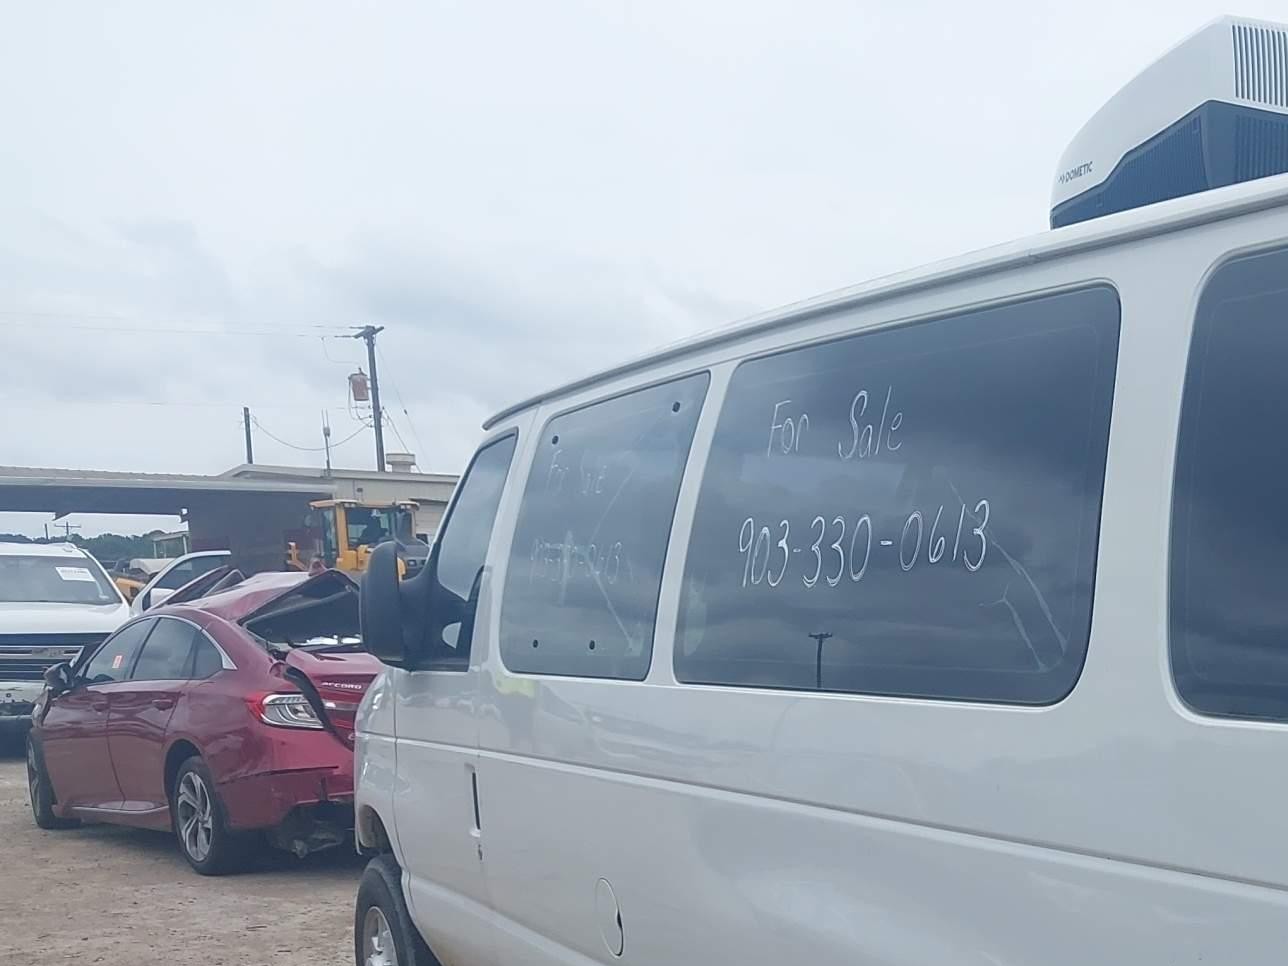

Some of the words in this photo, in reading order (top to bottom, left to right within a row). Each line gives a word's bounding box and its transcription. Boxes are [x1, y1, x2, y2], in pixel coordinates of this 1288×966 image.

[1065, 161, 1093, 184] DOMETIC
[768, 400, 809, 457] For
[838, 384, 904, 459] Sale
[738, 500, 990, 588] 903-330-0613
